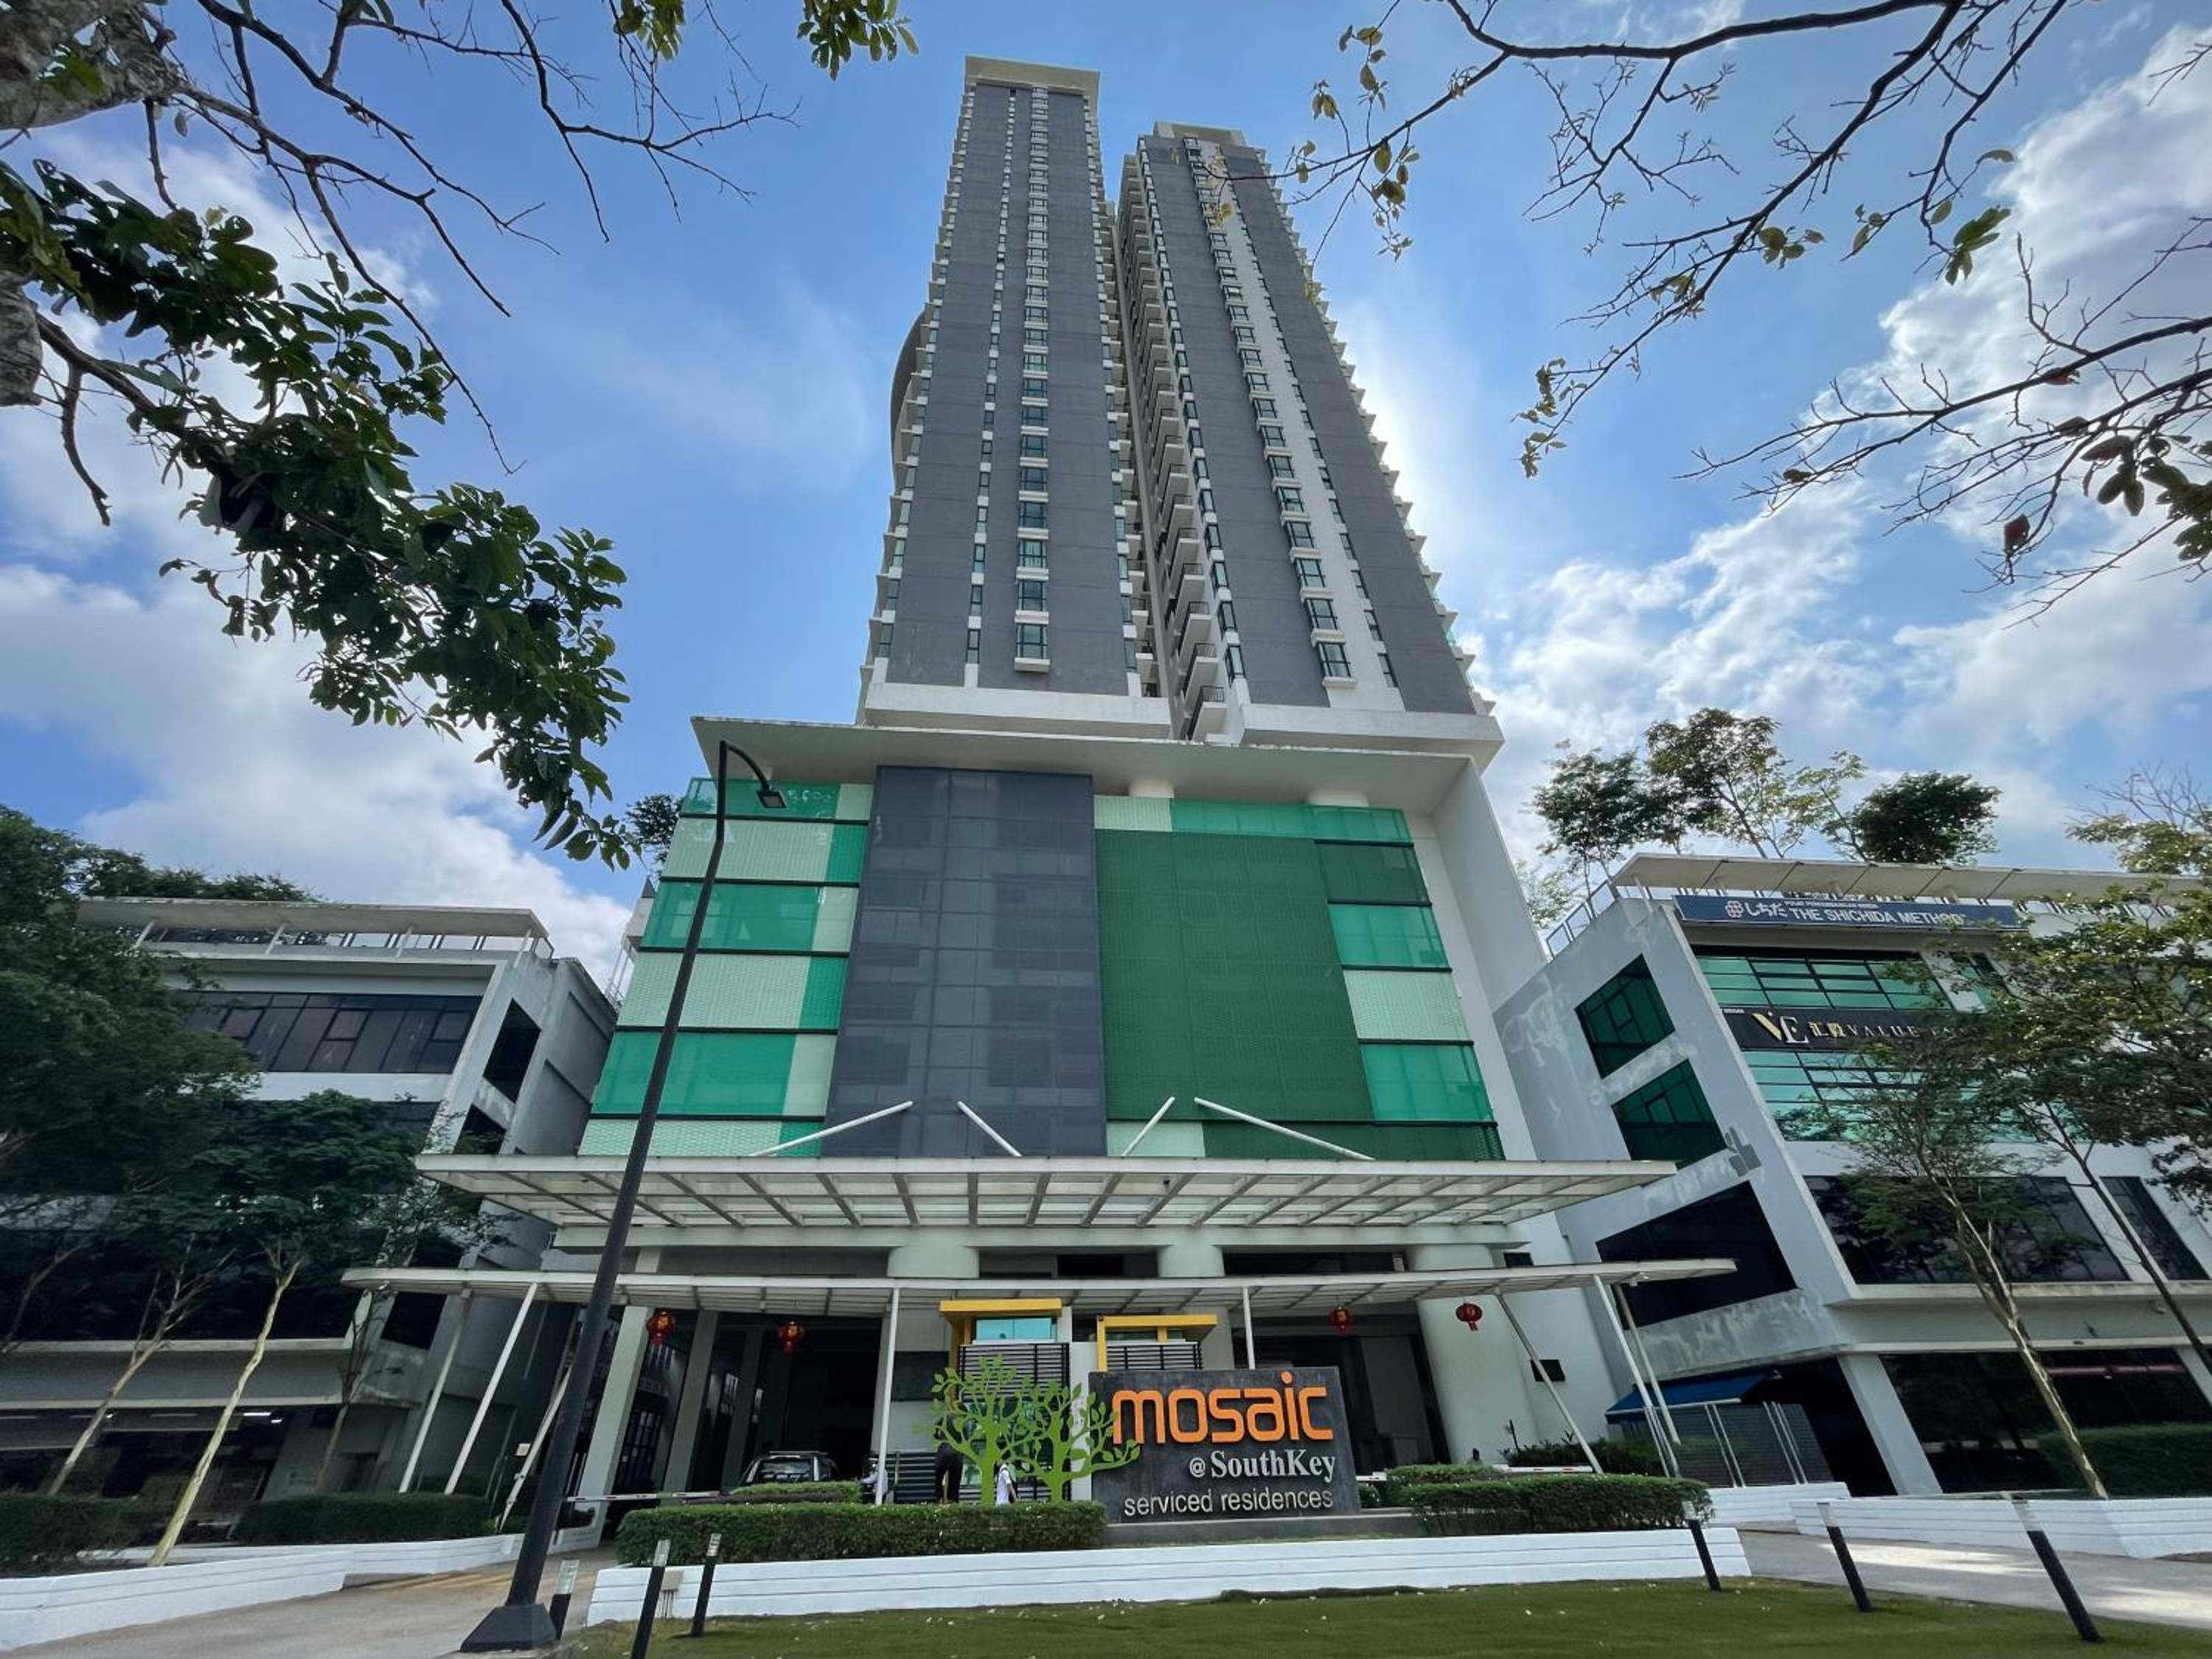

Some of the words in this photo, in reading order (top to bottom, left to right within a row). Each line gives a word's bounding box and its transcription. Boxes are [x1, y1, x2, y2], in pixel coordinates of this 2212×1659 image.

[1790, 908, 1823, 921] THE
[1823, 909, 1897, 923] SHICHIDA
[1112, 1371, 1334, 1444] mosaic
[1124, 1489, 1213, 1517] serviced
[1220, 1485, 1334, 1512] residences
